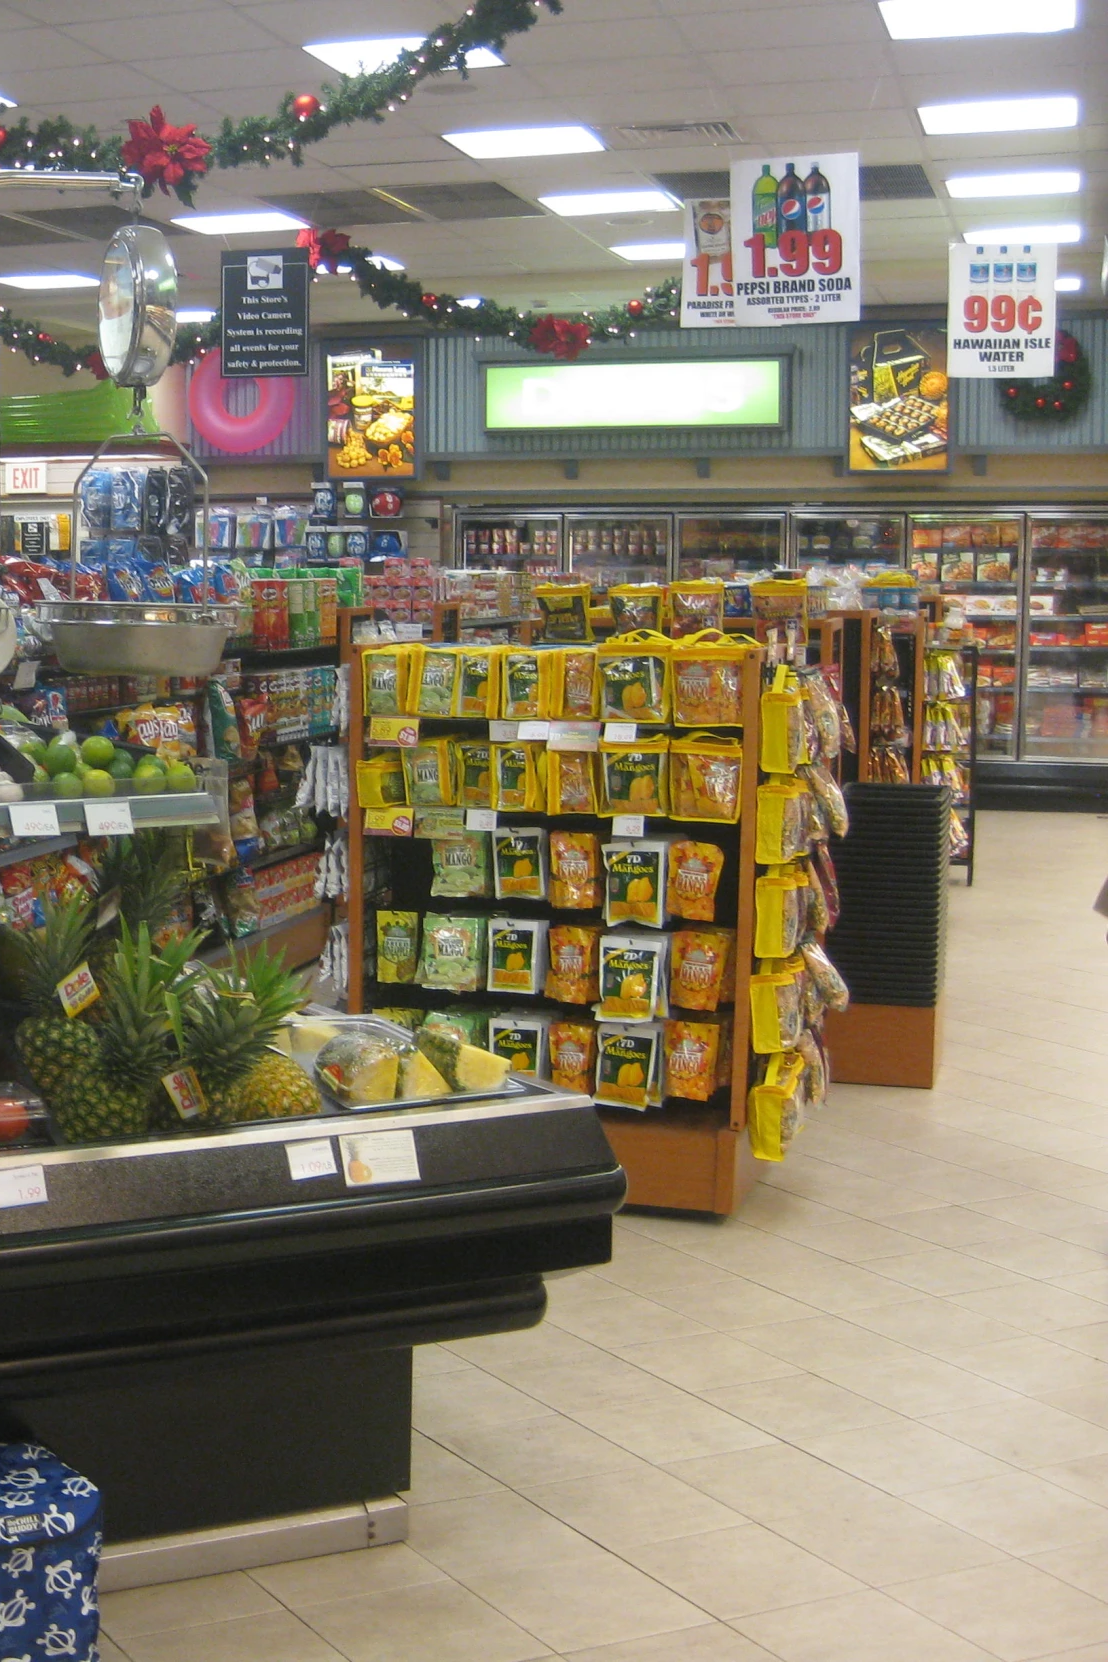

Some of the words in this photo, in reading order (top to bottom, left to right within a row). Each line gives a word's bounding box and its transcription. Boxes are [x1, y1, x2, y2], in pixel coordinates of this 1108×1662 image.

[744, 229, 842, 278] 1.99
[737, 281, 770, 295] PEPSI
[773, 279, 815, 293] BRAND
[819, 277, 852, 291] SODA
[241, 296, 259, 304] This
[261, 295, 288, 304] Store's
[747, 296, 784, 306] ASSORTED
[786, 295, 809, 304] TYPES
[821, 294, 841, 302] LITER
[687, 301, 723, 310] PARADISE
[237, 312, 259, 320] Video
[261, 311, 292, 320] Camera
[964, 295, 1042, 334] 99¢
[227, 328, 254, 338] System
[256, 328, 263, 336] is
[265, 327, 303, 336] recording
[230, 344, 240, 352] all
[267, 343, 279, 351] for
[281, 344, 299, 352] your
[953, 339, 1020, 349] HAWAIIAN
[1024, 338, 1051, 349] ISLE
[979, 351, 1024, 362] WATER
[227, 360, 249, 369] safety
[259, 359, 302, 369] protection.
[13, 468, 39, 489] EXIT
[628, 753, 642, 762] 7D
[614, 762, 655, 772] Mangoes
[445, 851, 472, 866] MANGO
[626, 855, 641, 863] 7D
[612, 863, 654, 874] Mangoes
[506, 933, 518, 941] 7D
[495, 940, 528, 950] Mangoes
[623, 952, 638, 960] 7D
[608, 960, 649, 970] Mangoes
[64, 972, 90, 997] Dole
[509, 1032, 522, 1041] 7D
[498, 1040, 533, 1050] Mangoes
[620, 1038, 635, 1048] 7D
[605, 1047, 646, 1060] Mangoes
[172, 1073, 195, 1110] Dole
[18, 1186, 41, 1200] 1.99
[8, 1522, 39, 1533] BUDDY
